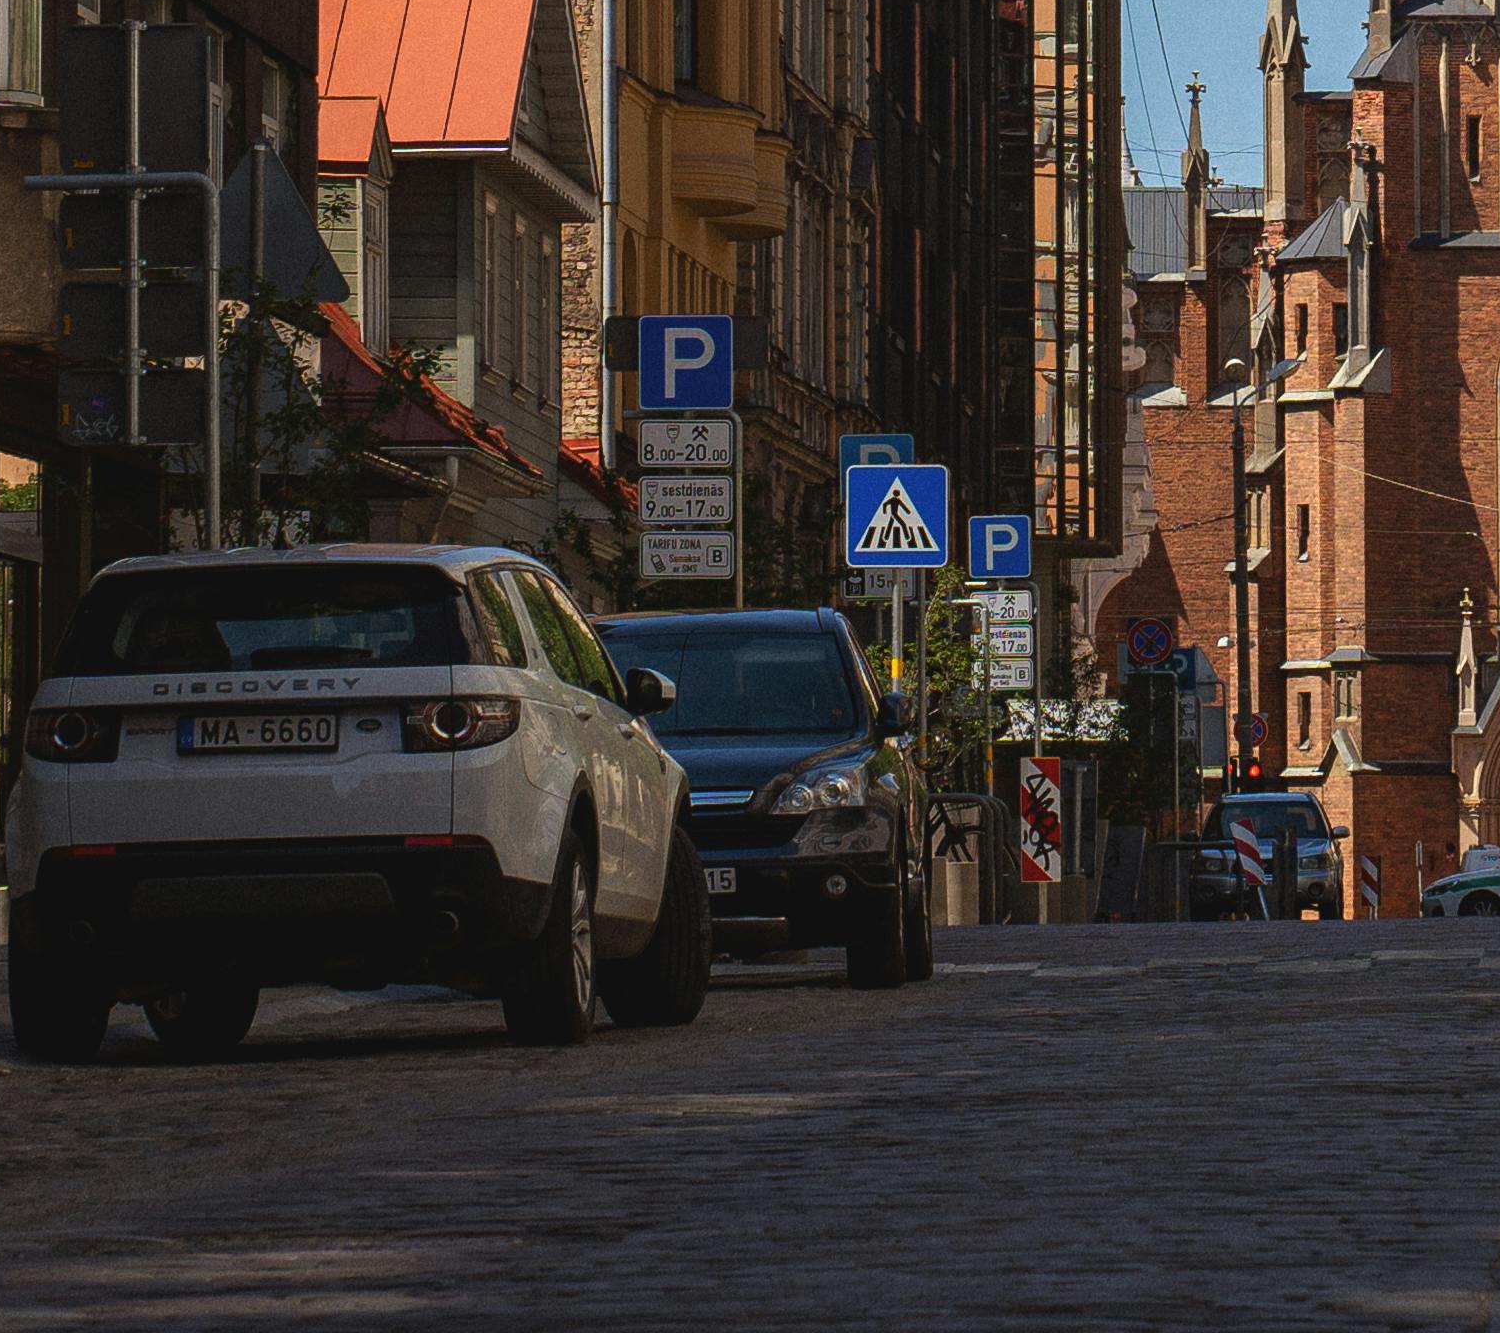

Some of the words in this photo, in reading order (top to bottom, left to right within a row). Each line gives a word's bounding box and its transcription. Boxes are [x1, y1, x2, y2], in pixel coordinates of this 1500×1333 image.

[664, 327, 715, 399] P
[643, 443, 728, 461] 8.00-20.00
[661, 483, 725, 497] sestdienās
[645, 499, 725, 518] 9.00-17.00
[647, 538, 677, 550] TARIFU
[680, 538, 702, 550] ZONA
[985, 524, 1019, 571] P
[712, 549, 723, 563] B
[153, 677, 360, 696] DISCOVERY
[201, 717, 332, 746] MA-6660
